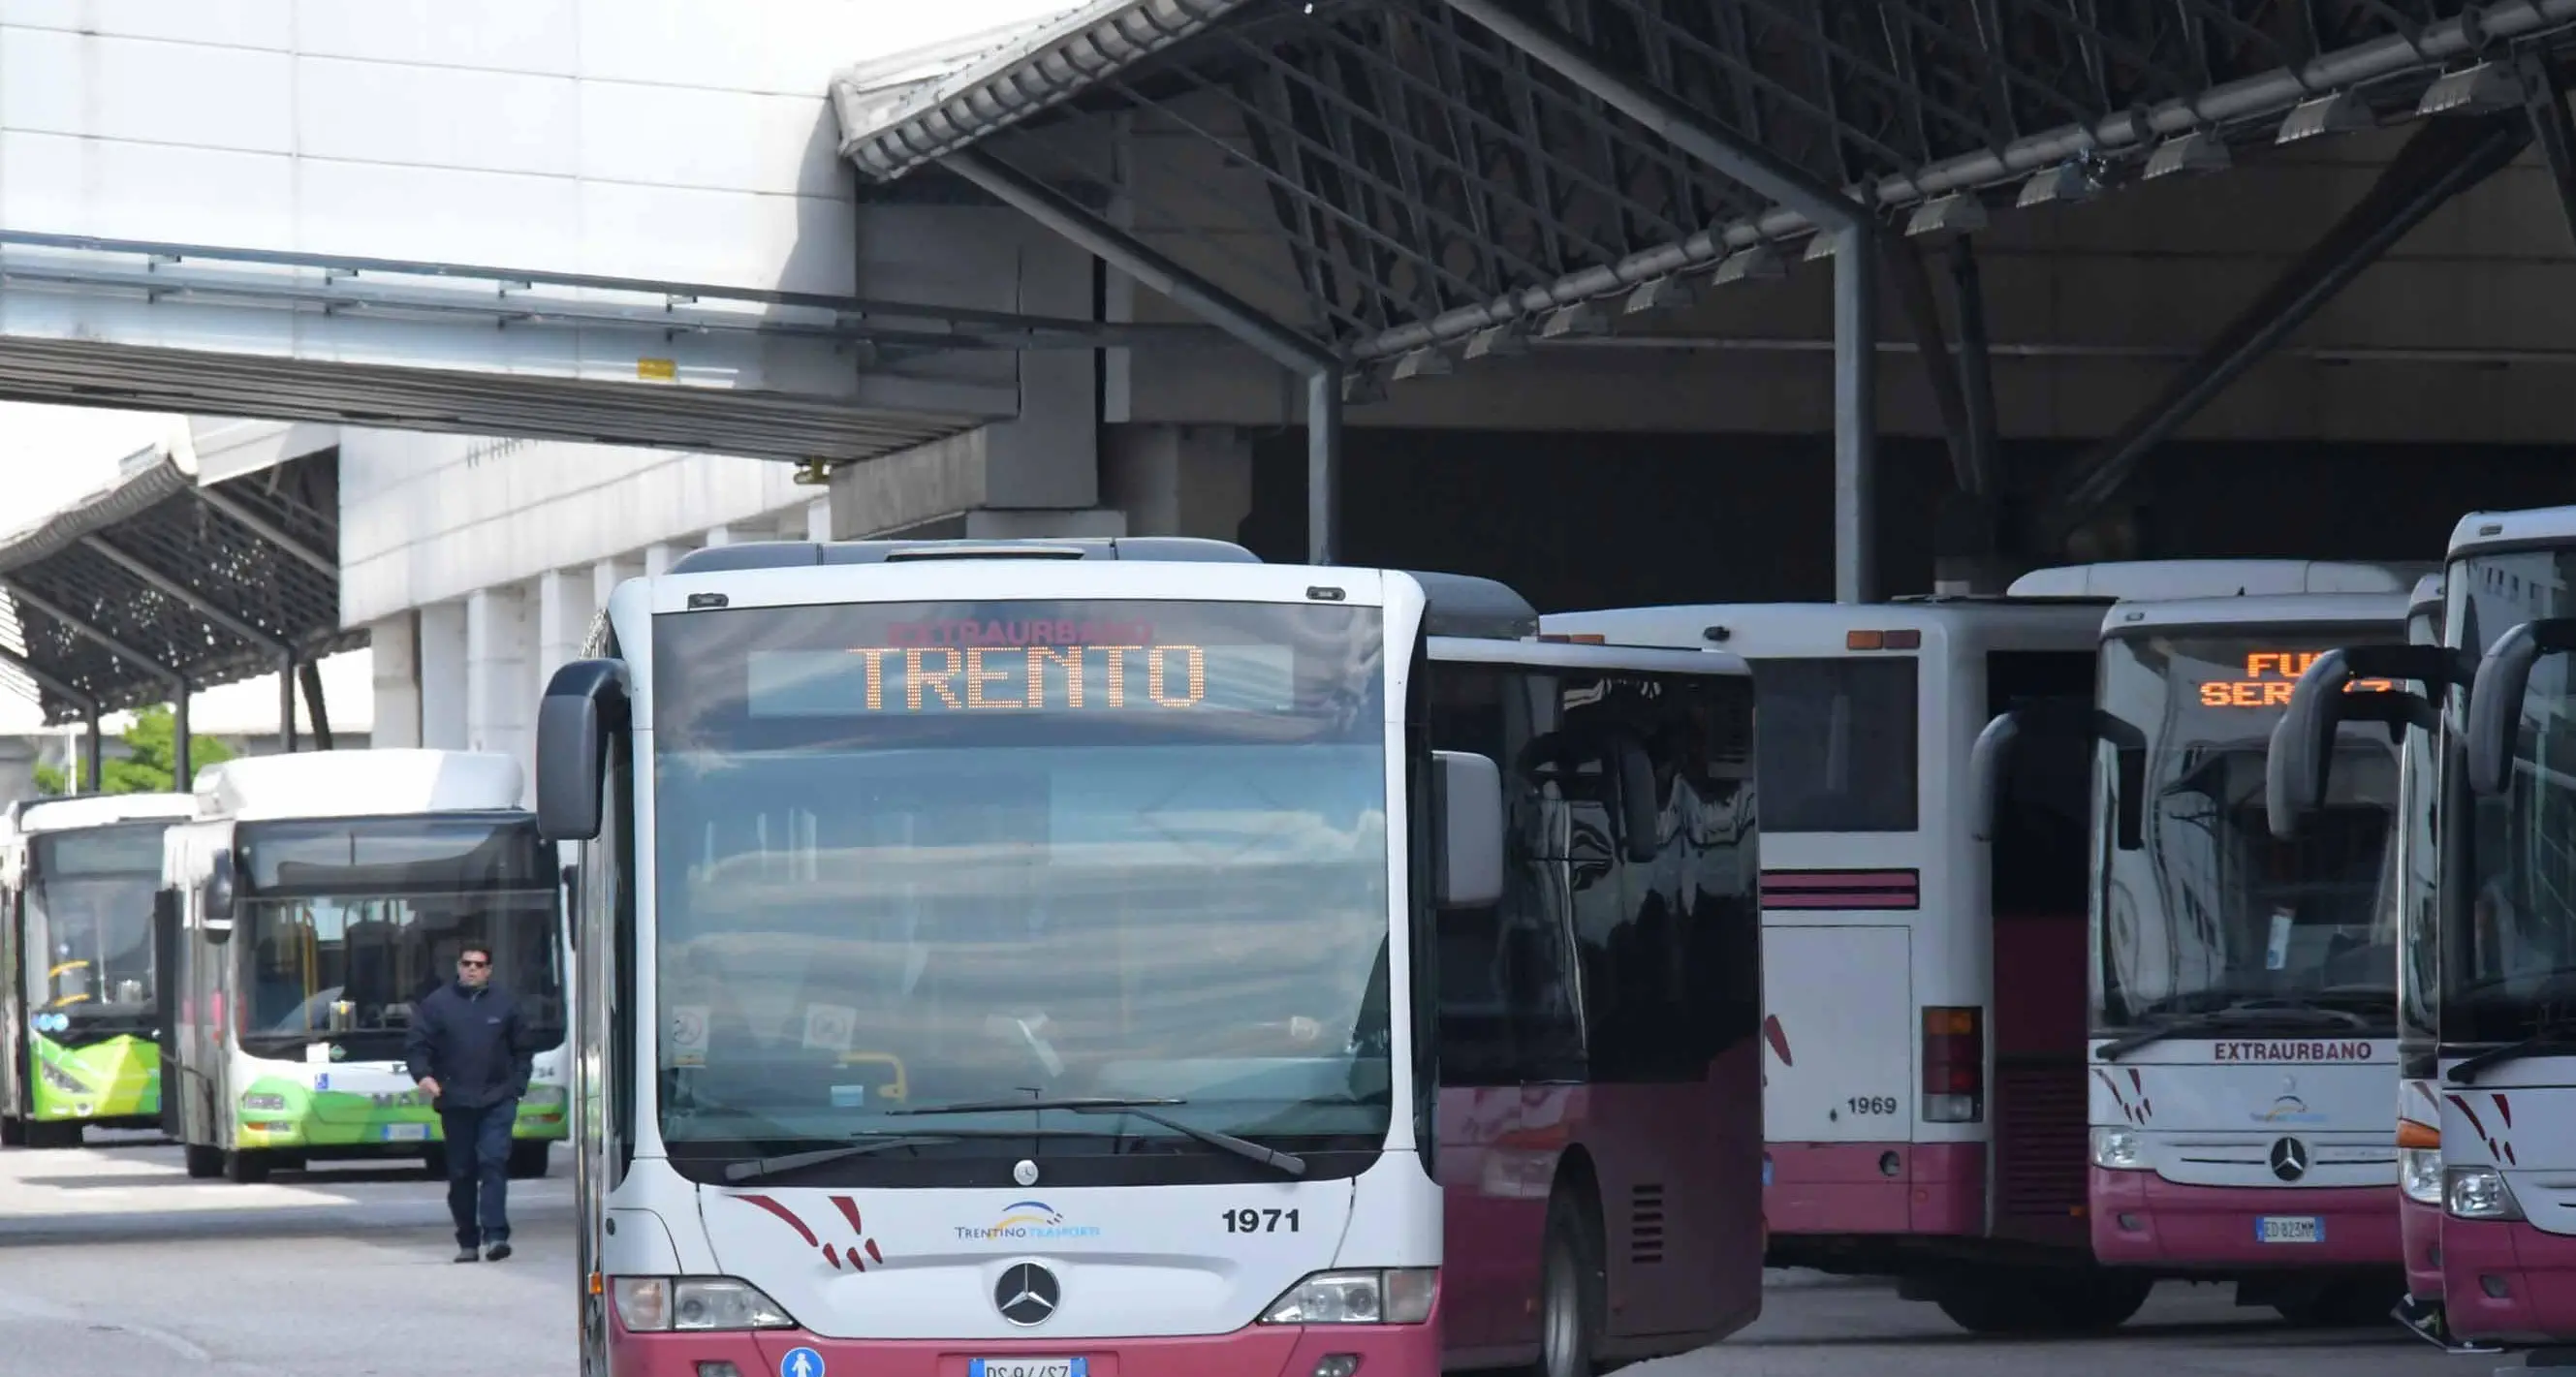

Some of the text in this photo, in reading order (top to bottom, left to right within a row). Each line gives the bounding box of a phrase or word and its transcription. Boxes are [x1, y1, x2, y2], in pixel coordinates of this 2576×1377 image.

[888, 619, 1153, 646] EXTRAURBANO
[846, 644, 1205, 709] TRENTO
[2215, 1042, 2372, 1060] EXTRAURBANO
[1847, 1096, 1897, 1115] 1969
[1221, 1207, 1300, 1233] 1971
[955, 1226, 1025, 1239] TRENTINO
